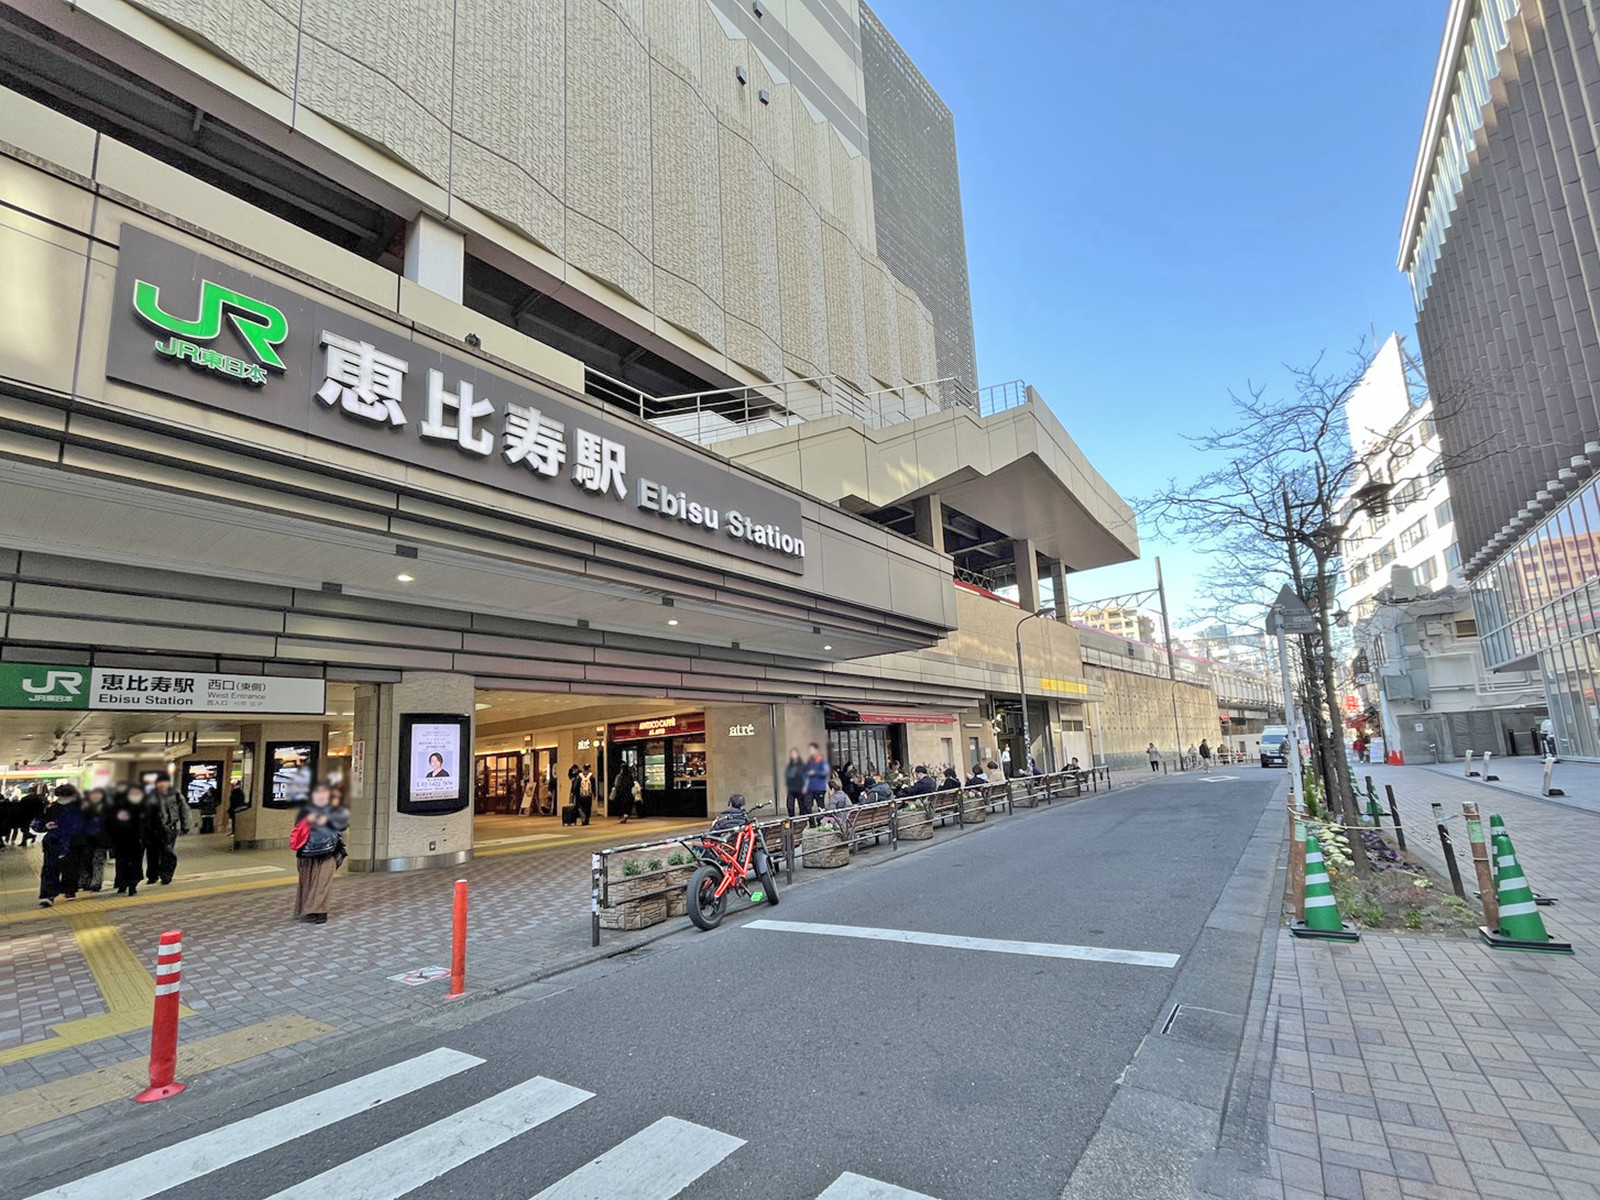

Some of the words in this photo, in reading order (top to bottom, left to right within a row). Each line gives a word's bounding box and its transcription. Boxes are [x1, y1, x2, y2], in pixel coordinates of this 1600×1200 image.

[133, 279, 288, 370] JR
[154, 336, 268, 385] JR東日本
[315, 329, 628, 500] 恵比寿駅
[637, 477, 719, 530] Ebisu
[725, 509, 806, 558] Station
[22, 671, 83, 695] JR
[101, 674, 195, 694] 恵比寿駅
[99, 693, 141, 704] Ebisu
[145, 695, 194, 706] Station
[208, 691, 229, 699] West
[231, 692, 267, 700] Entrance
[729, 723, 756, 737] atré
